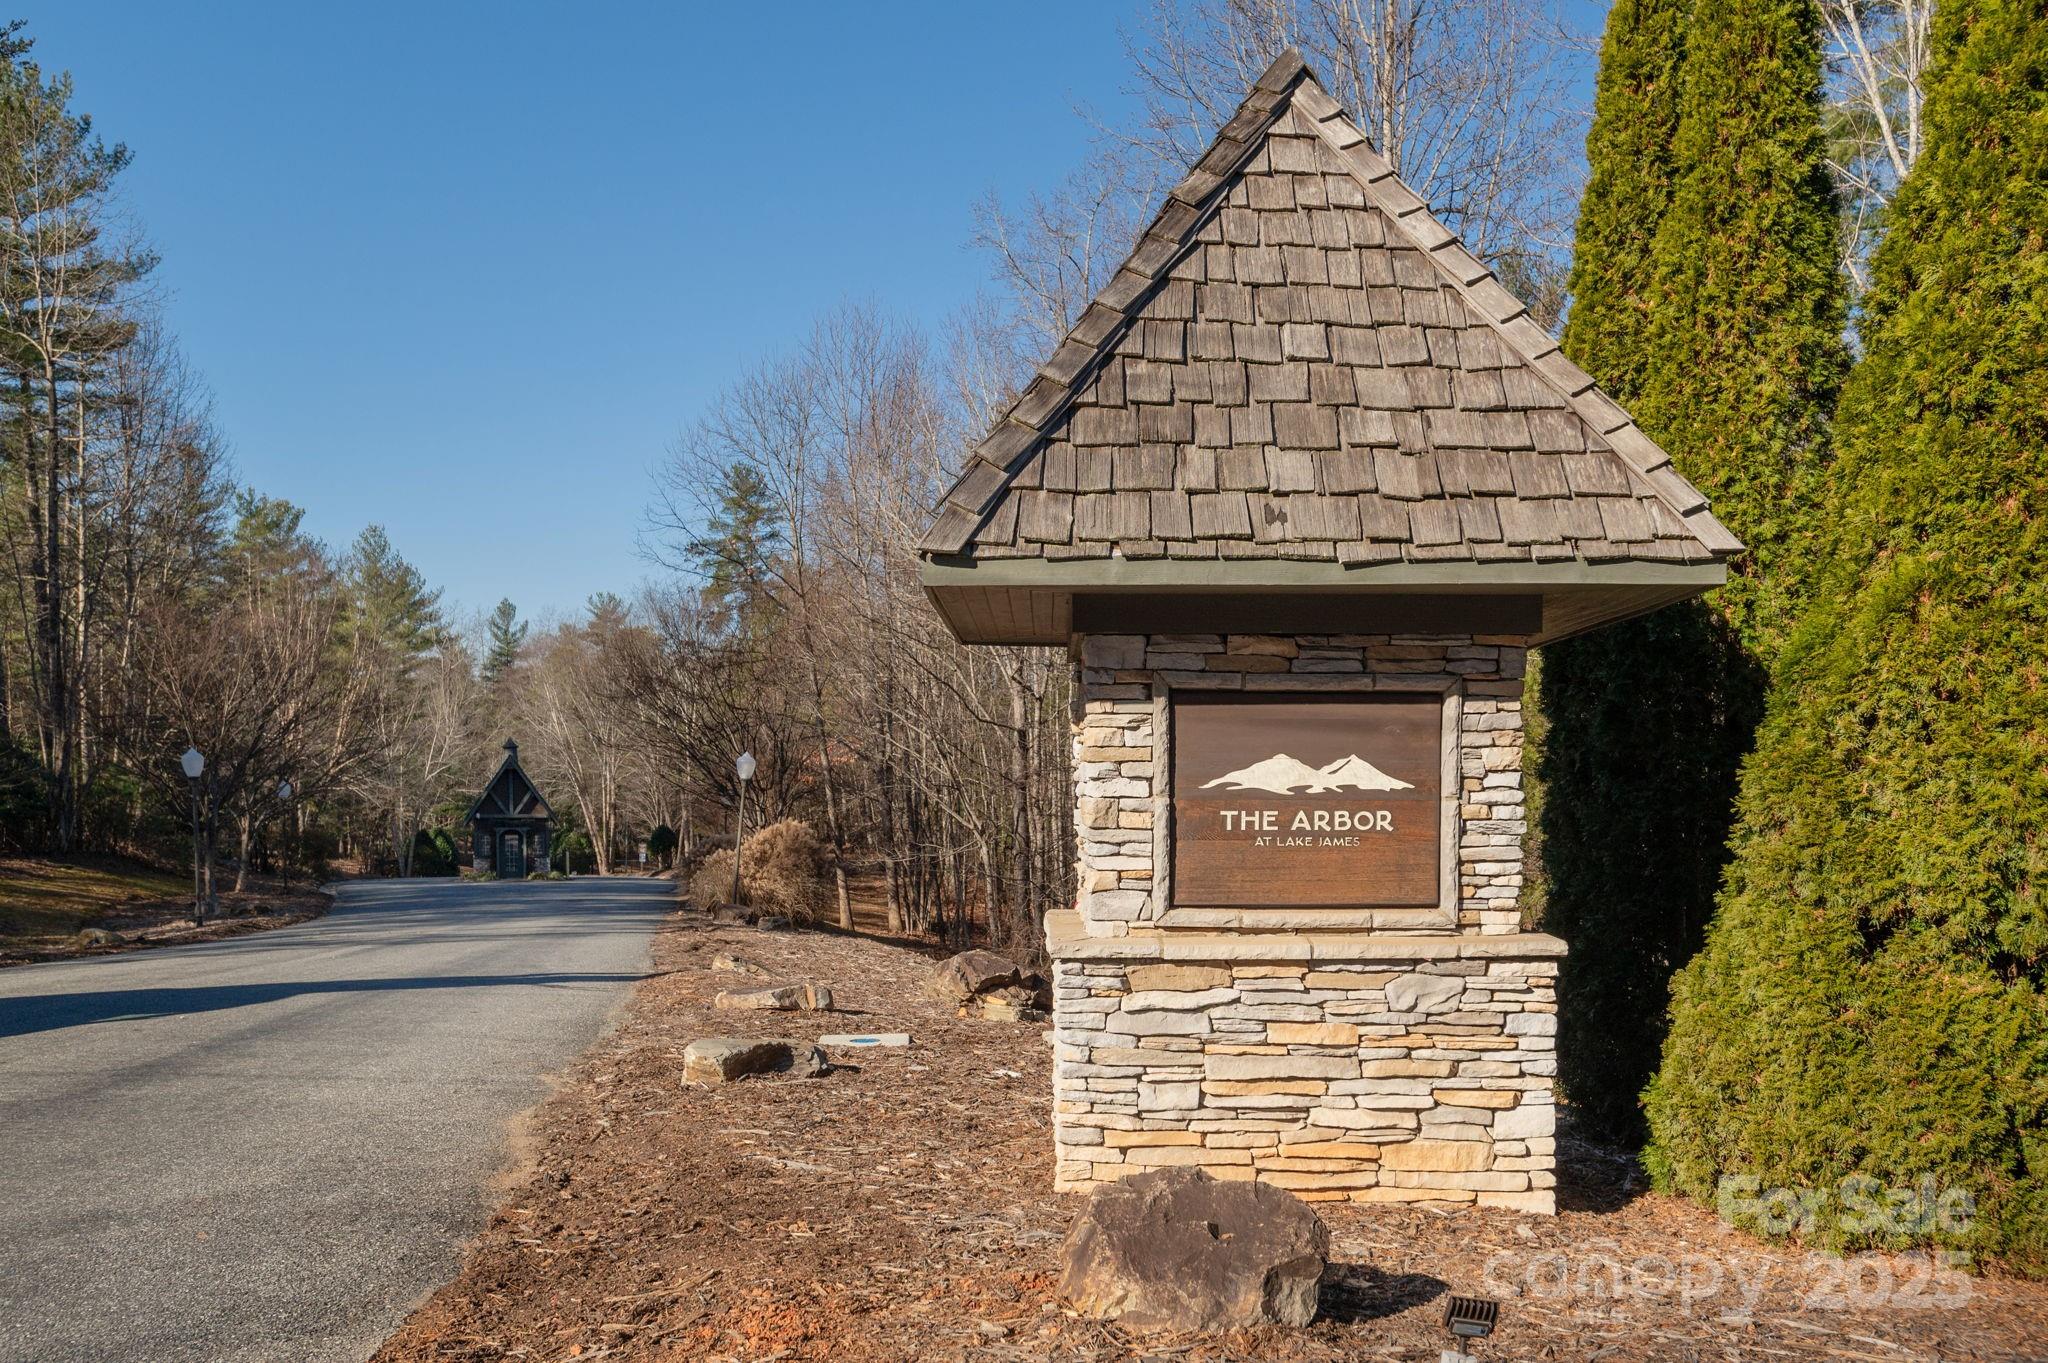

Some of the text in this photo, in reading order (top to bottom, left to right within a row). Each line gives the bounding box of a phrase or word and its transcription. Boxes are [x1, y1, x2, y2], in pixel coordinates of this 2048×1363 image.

[1220, 810, 1394, 832] THE ARBOR
[1254, 836, 1360, 847] AT LAKE JAMES
